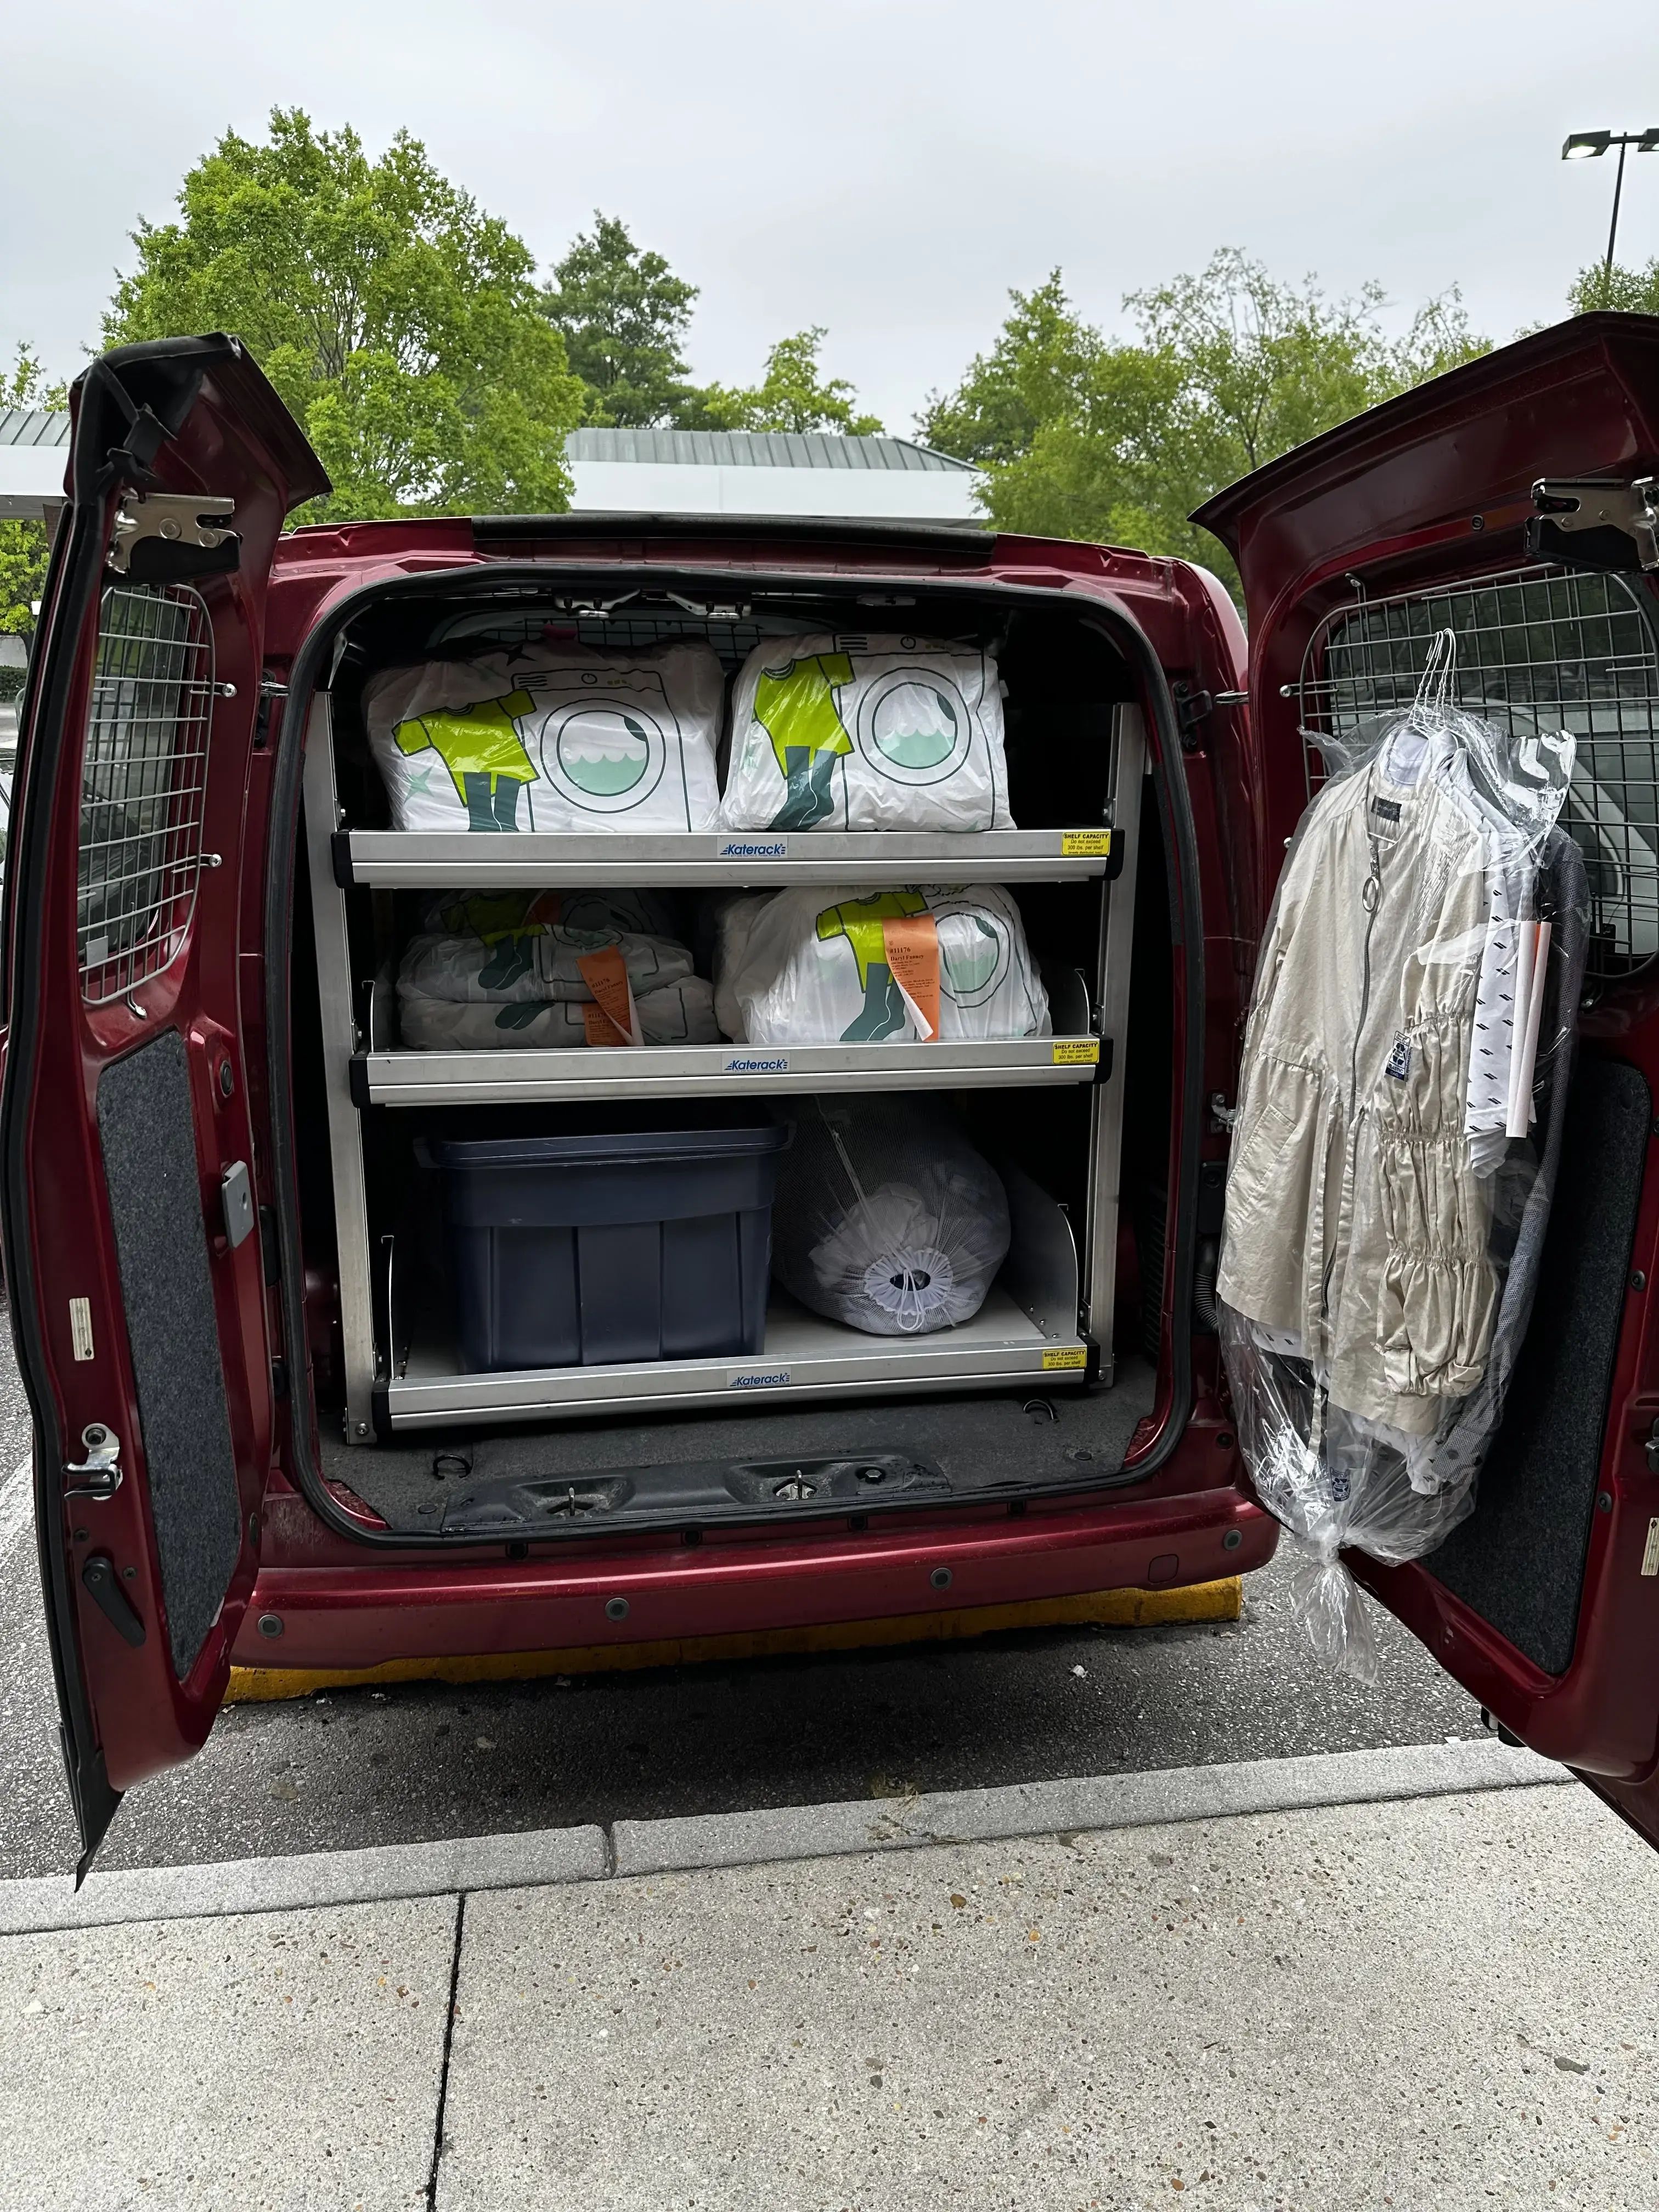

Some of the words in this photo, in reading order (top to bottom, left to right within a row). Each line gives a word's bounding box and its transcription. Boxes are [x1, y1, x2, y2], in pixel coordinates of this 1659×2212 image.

[727, 843, 781, 855] Katerack
[731, 1059, 783, 1070] Katerack
[737, 1373, 786, 1386] Katerack
